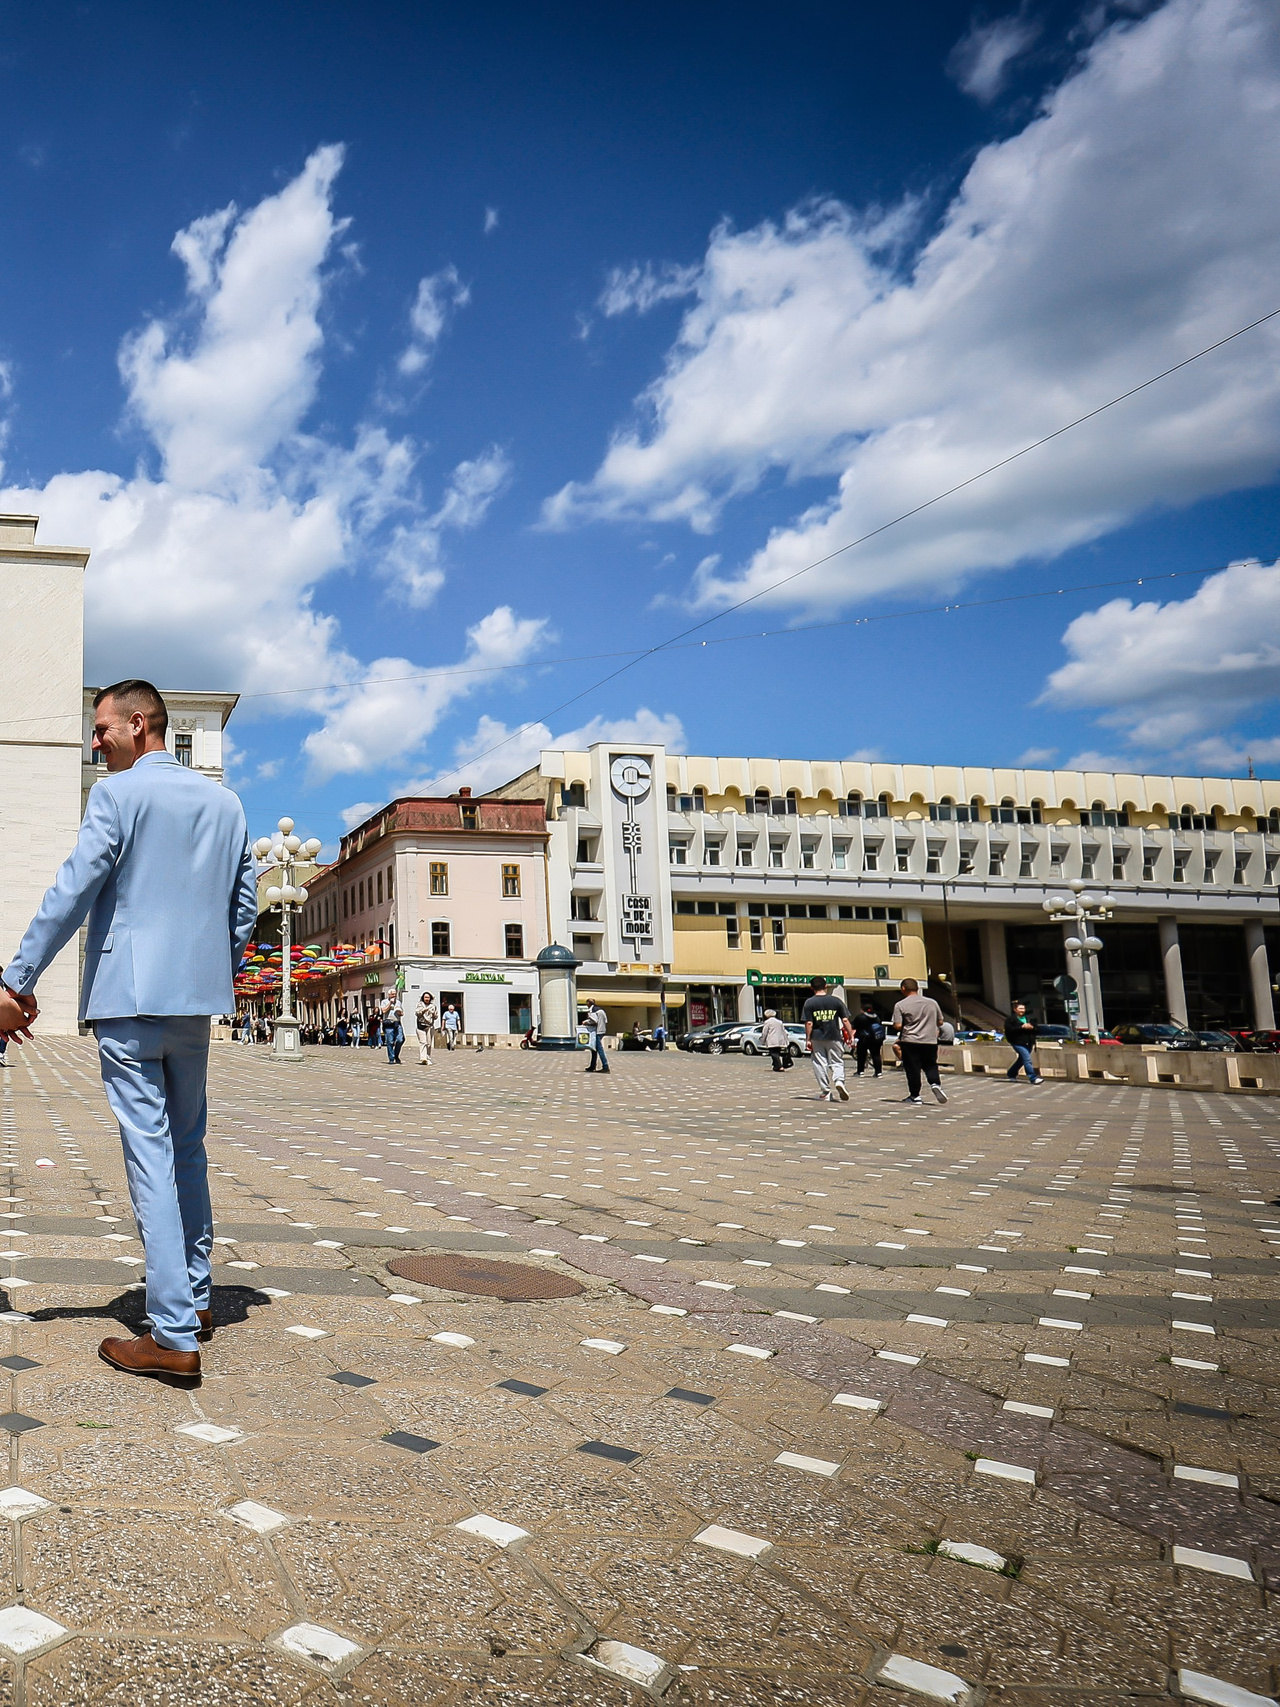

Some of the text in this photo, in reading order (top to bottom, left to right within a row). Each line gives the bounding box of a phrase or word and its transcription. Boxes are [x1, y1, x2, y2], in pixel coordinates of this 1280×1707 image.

[627, 897, 650, 909] CASA
[633, 911, 645, 921] DE
[626, 922, 651, 934] MODE
[465, 972, 505, 982] SPARTAN
